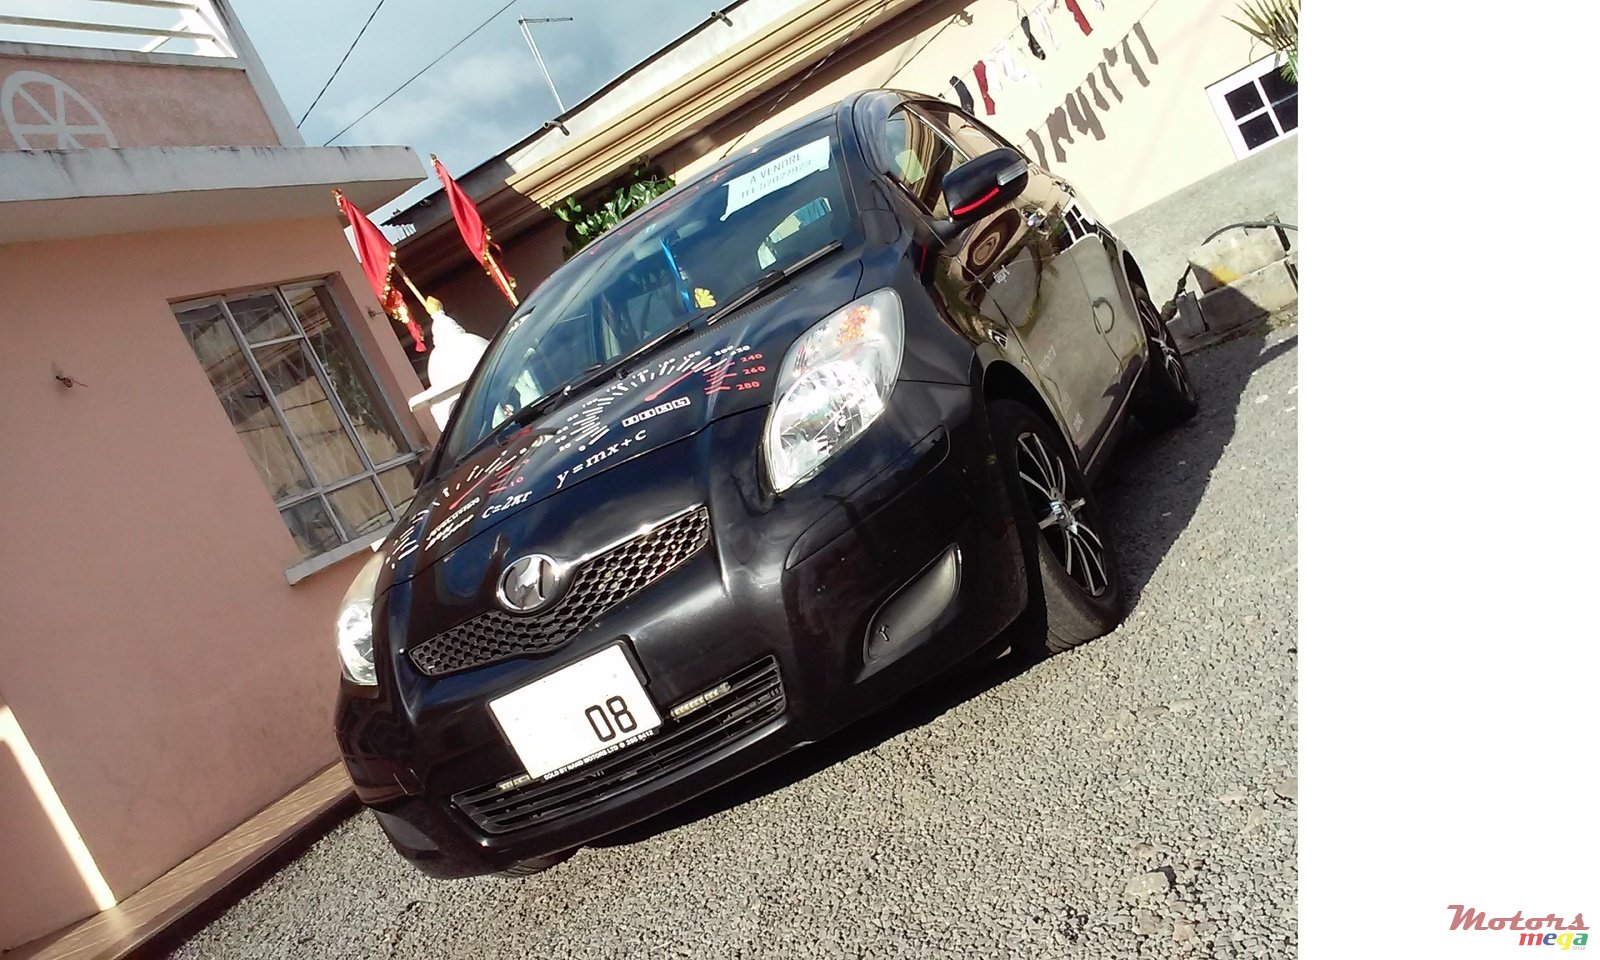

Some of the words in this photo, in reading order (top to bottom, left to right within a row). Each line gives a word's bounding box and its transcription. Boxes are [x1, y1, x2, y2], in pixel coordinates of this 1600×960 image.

[749, 175, 757, 185] A
[740, 353, 763, 363] 240
[742, 365, 766, 375] 260
[736, 381, 760, 391] 280
[585, 695, 637, 742] 08
[543, 770, 560, 781] SOLD
[559, 766, 568, 775] BY
[582, 749, 608, 764] MOTORS
[607, 745, 619, 754] LTD
